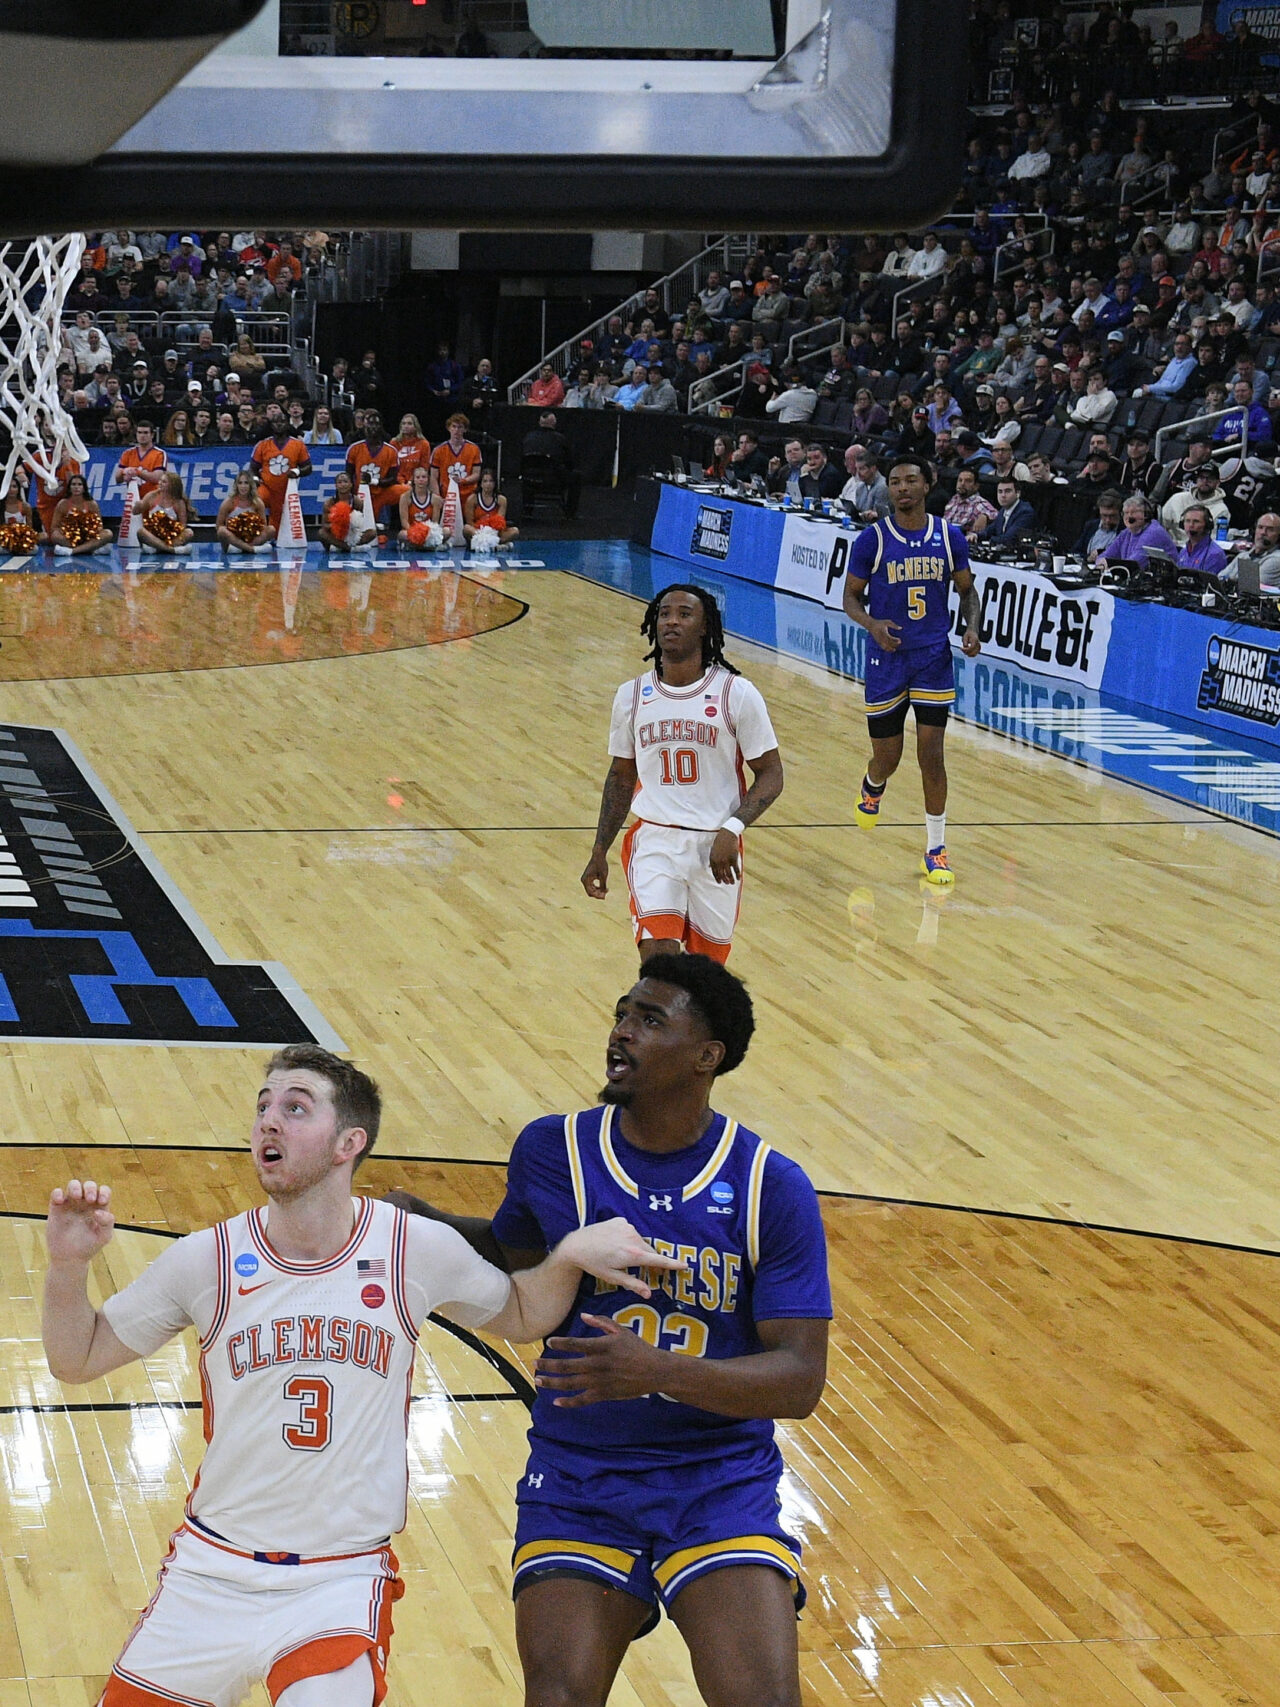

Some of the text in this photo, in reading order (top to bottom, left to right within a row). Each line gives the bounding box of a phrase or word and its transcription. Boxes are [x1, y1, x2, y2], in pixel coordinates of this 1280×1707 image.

[1245, 10, 1280, 26] MARC
[120, 492, 134, 539] CLEMSON
[287, 492, 303, 540] CLEMSON
[442, 492, 457, 532] CLEMS
[701, 509, 722, 531] MARCH
[699, 529, 730, 553] MADNESS
[791, 543, 830, 572] HOSTED BY
[328, 559, 546, 569] ROUND
[886, 557, 945, 585] McNEESE
[906, 586, 928, 621] 5
[980, 577, 1100, 673] COLLEGE
[1218, 643, 1268, 680] MARCH
[638, 718, 720, 749] CLEMSON
[658, 747, 701, 786] 10
[706, 1205, 736, 1215] SLC
[226, 1314, 396, 1381] CLEMSON
[282, 1374, 335, 1452] 3
